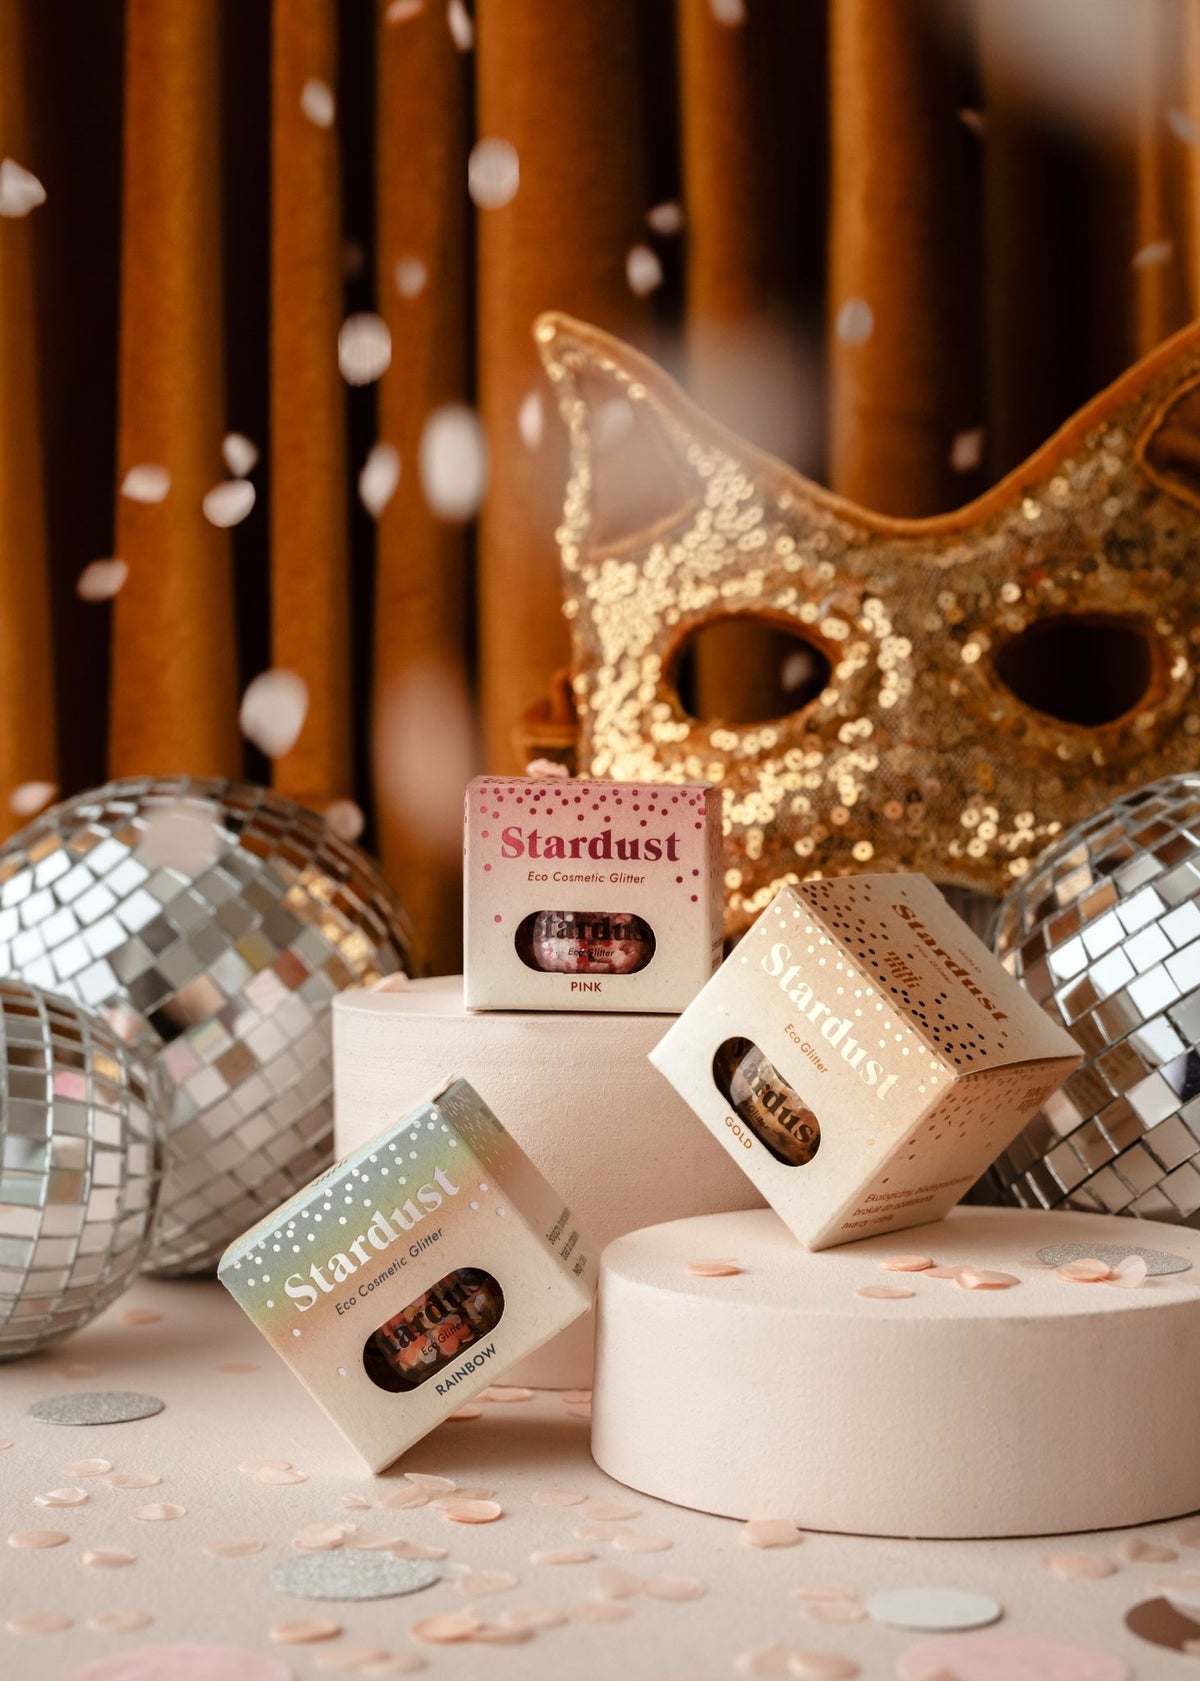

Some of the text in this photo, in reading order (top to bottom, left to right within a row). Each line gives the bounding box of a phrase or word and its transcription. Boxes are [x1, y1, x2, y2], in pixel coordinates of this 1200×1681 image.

[501, 826, 680, 862] Stardust
[527, 871, 646, 885] Eco Cosmetic Glitter
[587, 948, 614, 958] Glitter
[891, 903, 1009, 1023] Stardust
[570, 981, 602, 993] PINK
[761, 942, 900, 1102] Stardust
[784, 1023, 829, 1073] Eco Glitter
[724, 1115, 753, 1150] GOLD
[283, 1165, 460, 1313] Stardust
[334, 1227, 444, 1316] Eco Cosmetic Glitter
[421, 1321, 466, 1357] Eco Glitter
[434, 1343, 498, 1396] RAINBOW
